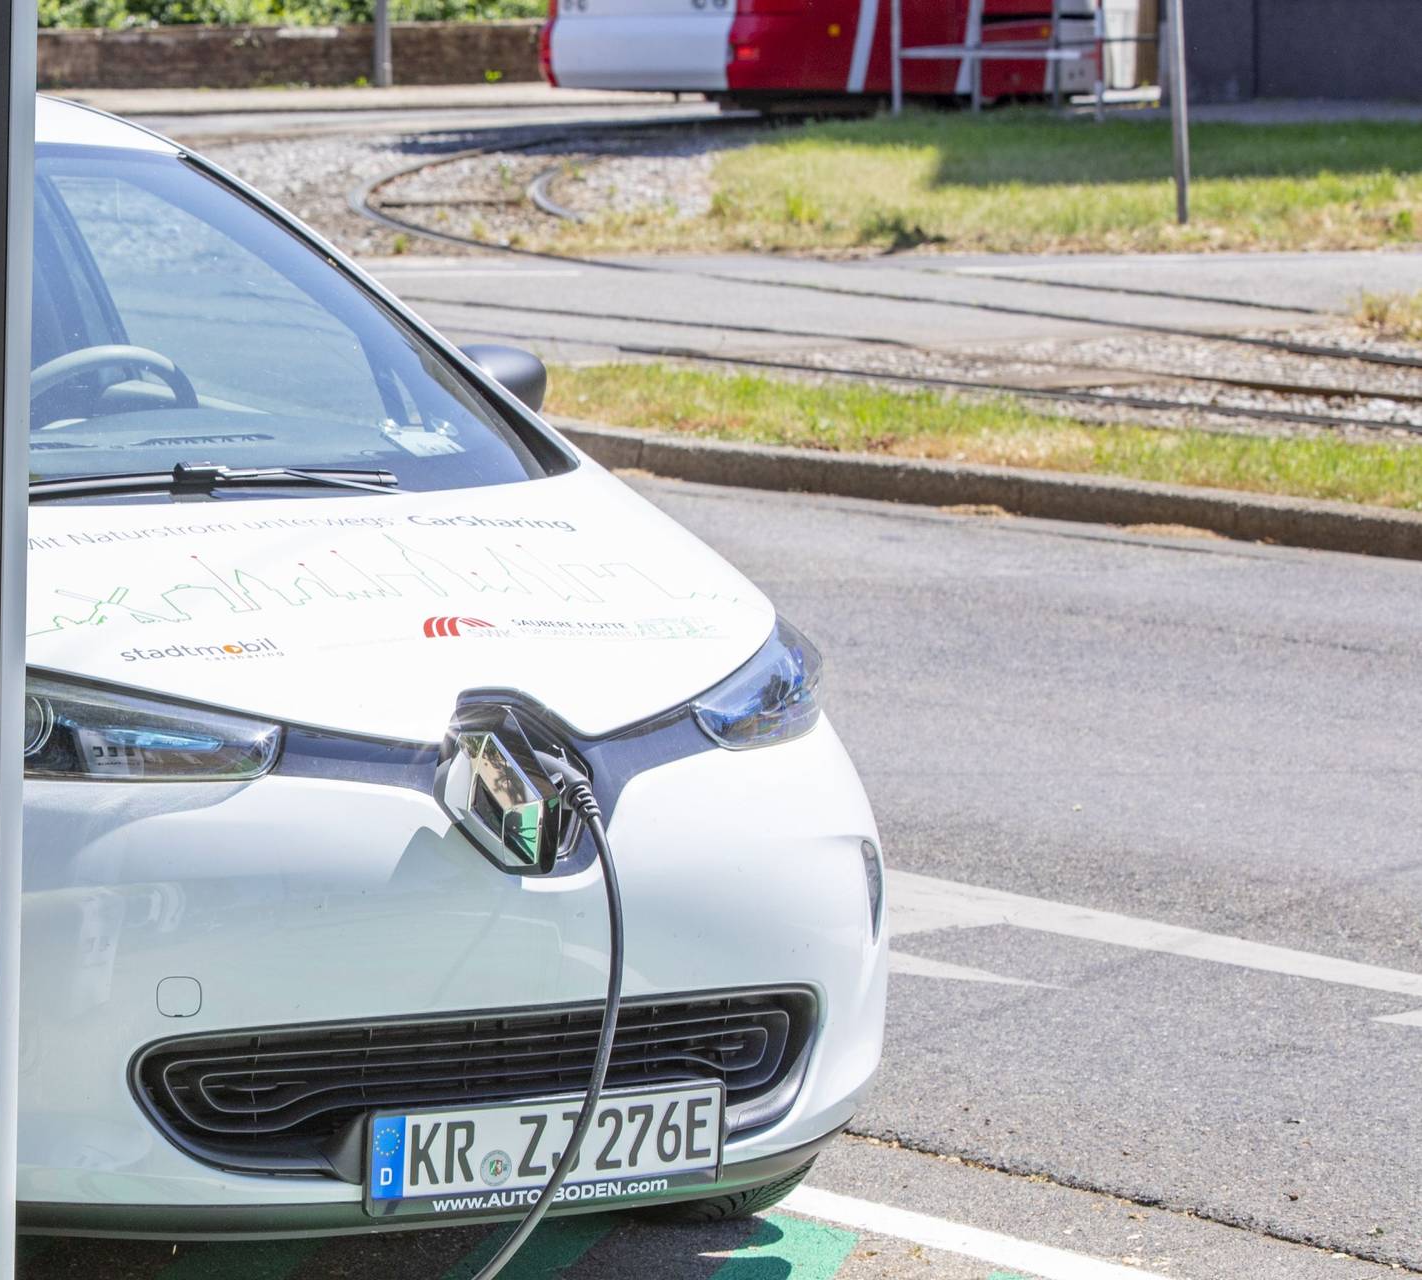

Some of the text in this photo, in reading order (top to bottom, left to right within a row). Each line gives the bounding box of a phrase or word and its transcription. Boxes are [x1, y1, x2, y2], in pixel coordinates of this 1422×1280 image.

[67, 522, 238, 546] Naturstrom
[407, 514, 577, 532] CarSharing
[120, 638, 278, 662] stadtmobil
[409, 1120, 475, 1186] KR
[595, 1097, 713, 1171] 276E
[380, 1168, 393, 1187] D
[432, 1178, 668, 1213] www.AUTOBODEN.com
